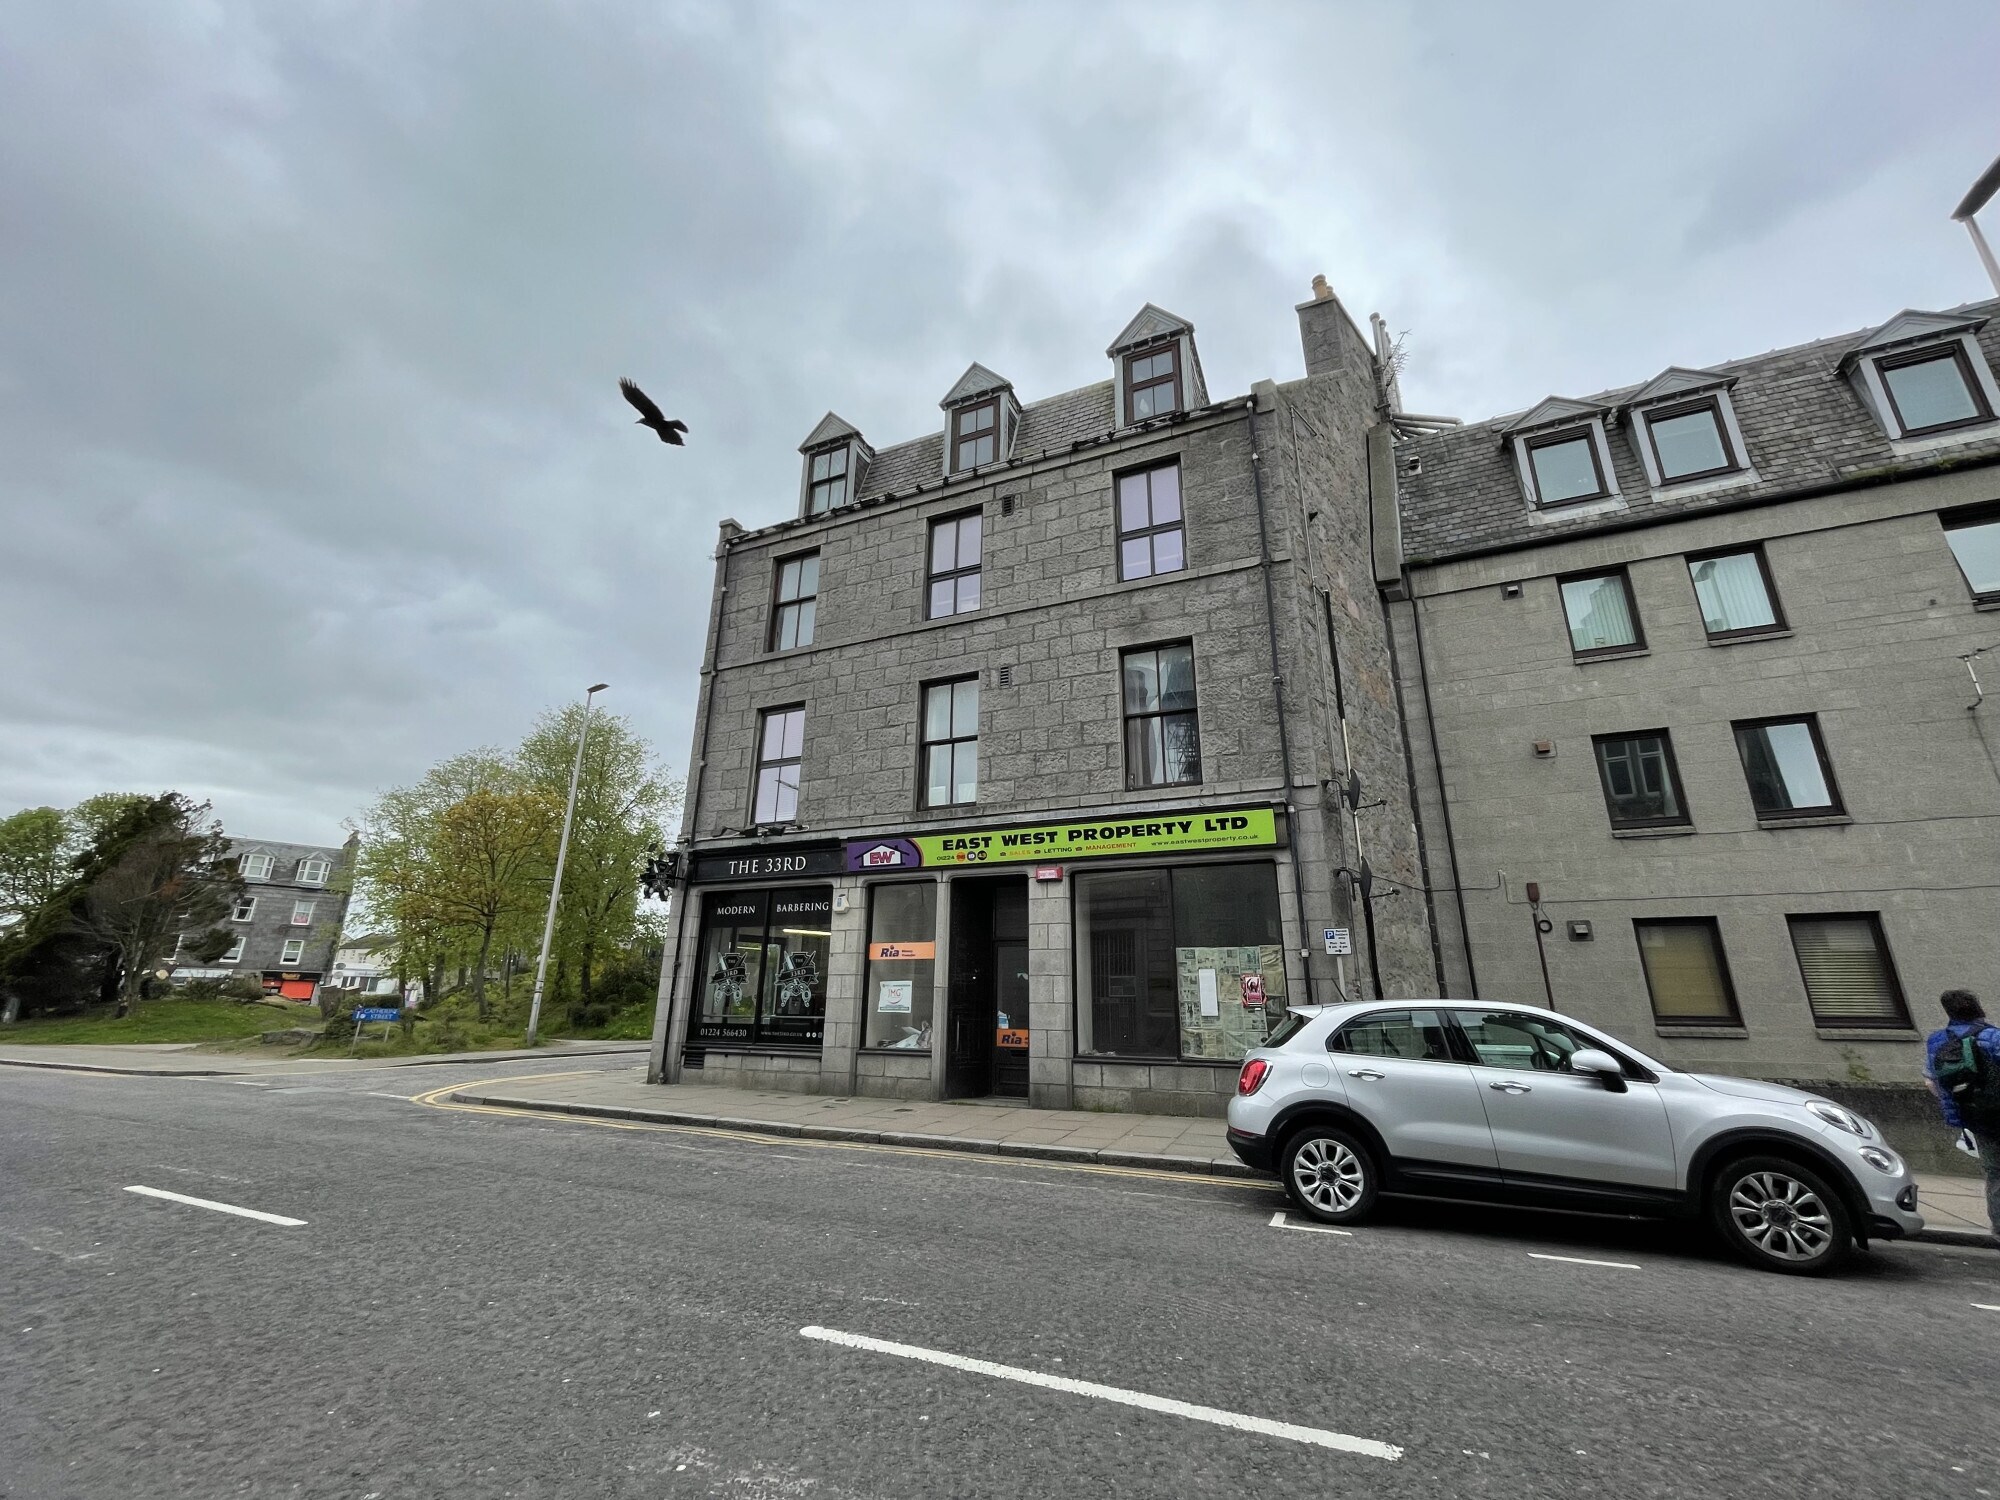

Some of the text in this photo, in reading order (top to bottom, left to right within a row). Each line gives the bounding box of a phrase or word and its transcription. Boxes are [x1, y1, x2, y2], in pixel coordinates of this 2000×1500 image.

[943, 816, 1249, 851] EAST WEST PROPERTY LTD
[1151, 833, 1259, 846] www.eastwestproperty.co.uk
[1043, 846, 1073, 854] LETTING
[1085, 842, 1137, 851] MANAGEMENT
[869, 850, 895, 865] EW
[728, 856, 807, 875] THE 33RD
[716, 902, 830, 915] MODERN BARBERING
[880, 944, 900, 958] Ria
[700, 1027, 747, 1037] 01224 566430
[1001, 1030, 1022, 1045] Ria
